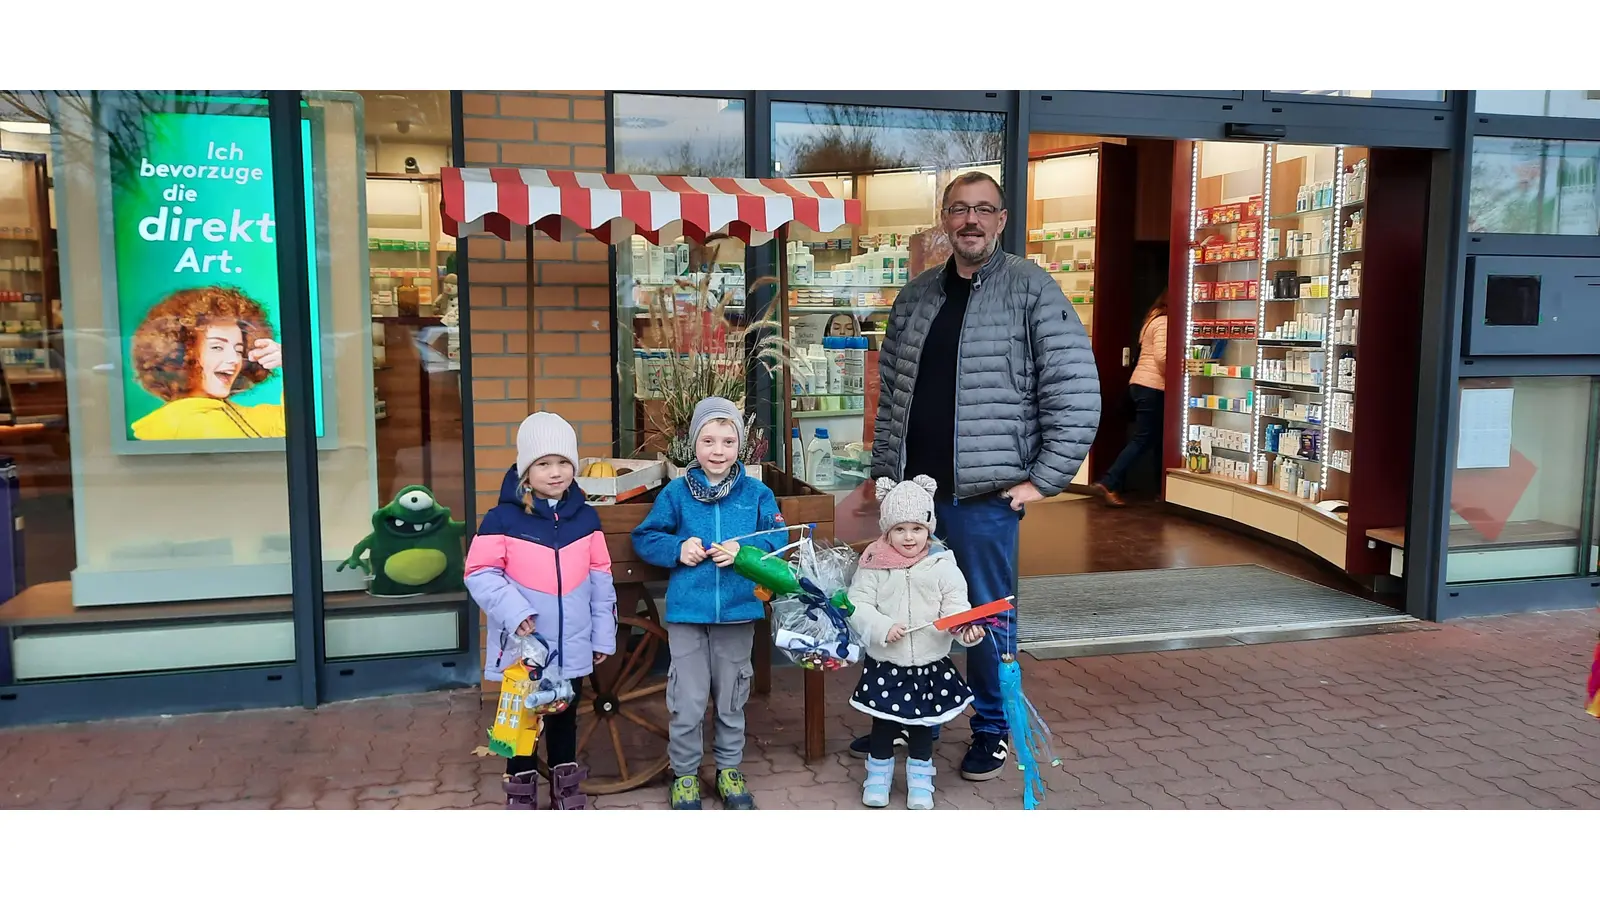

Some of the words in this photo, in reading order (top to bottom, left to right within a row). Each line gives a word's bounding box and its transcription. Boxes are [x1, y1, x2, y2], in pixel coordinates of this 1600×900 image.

[207, 142, 243, 160] Ich
[140, 158, 263, 184] bevorzuge
[163, 184, 197, 201] die
[139, 206, 275, 242] direkt
[174, 247, 242, 273] Art.
